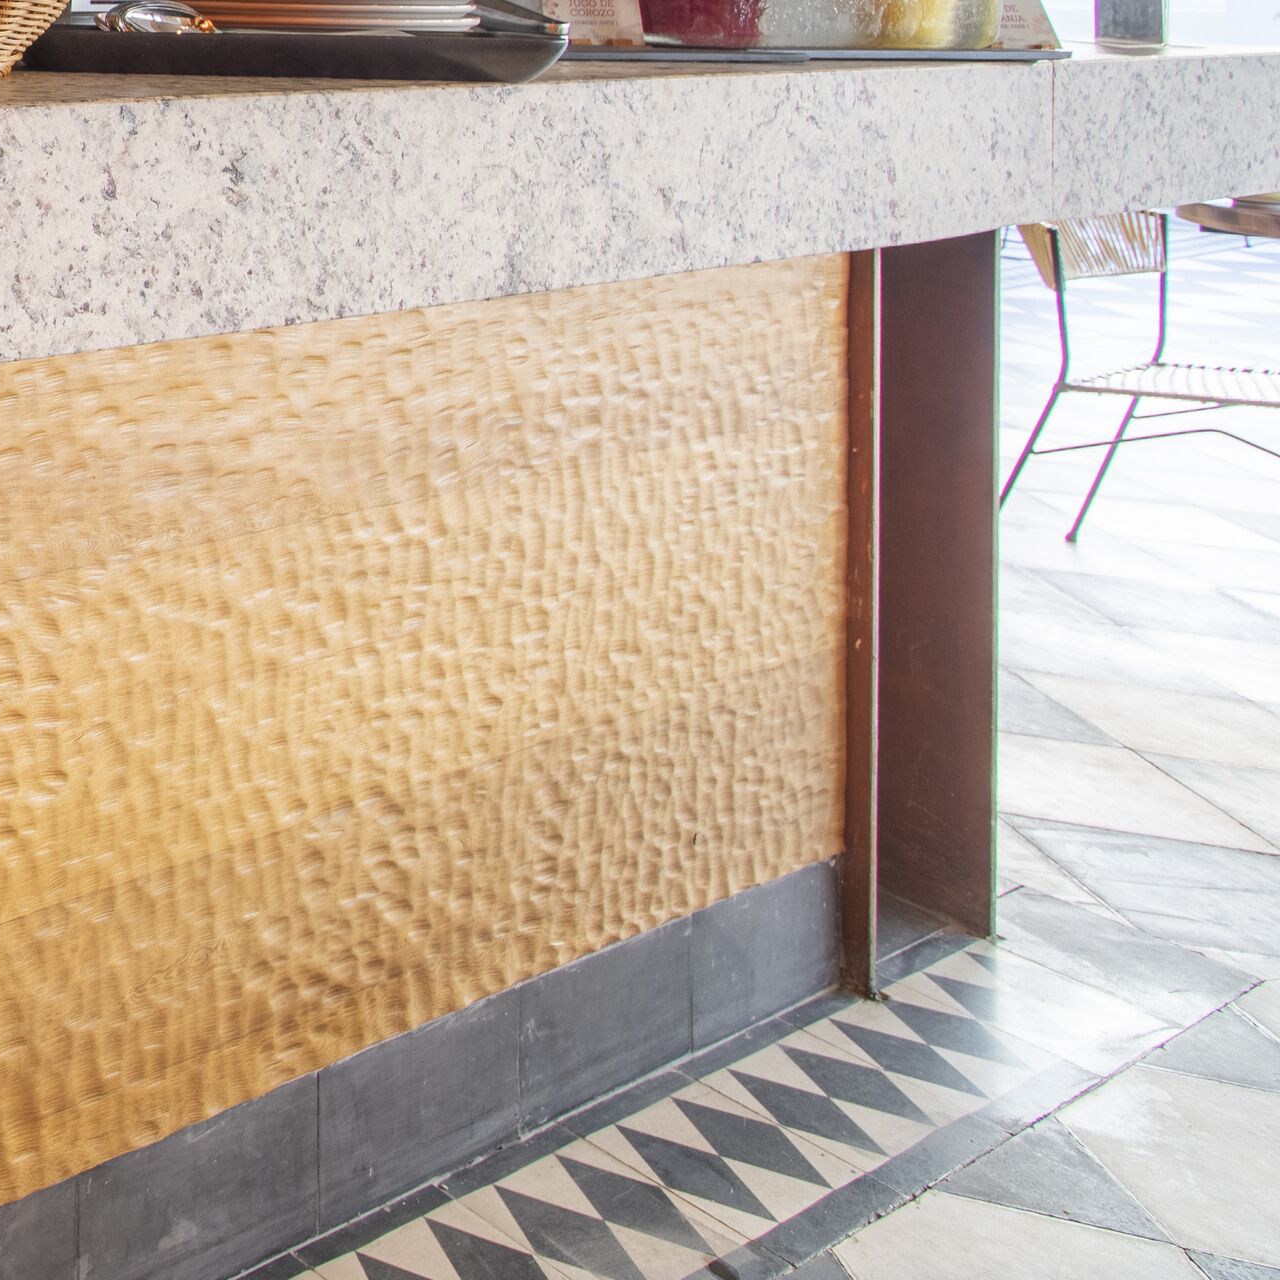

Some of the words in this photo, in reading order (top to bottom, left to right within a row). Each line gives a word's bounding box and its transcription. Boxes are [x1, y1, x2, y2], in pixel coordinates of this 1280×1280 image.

[569, 0, 597, 8] JUGO
[600, 0, 615, 8] DE
[570, 8, 615, 17] COROZO
